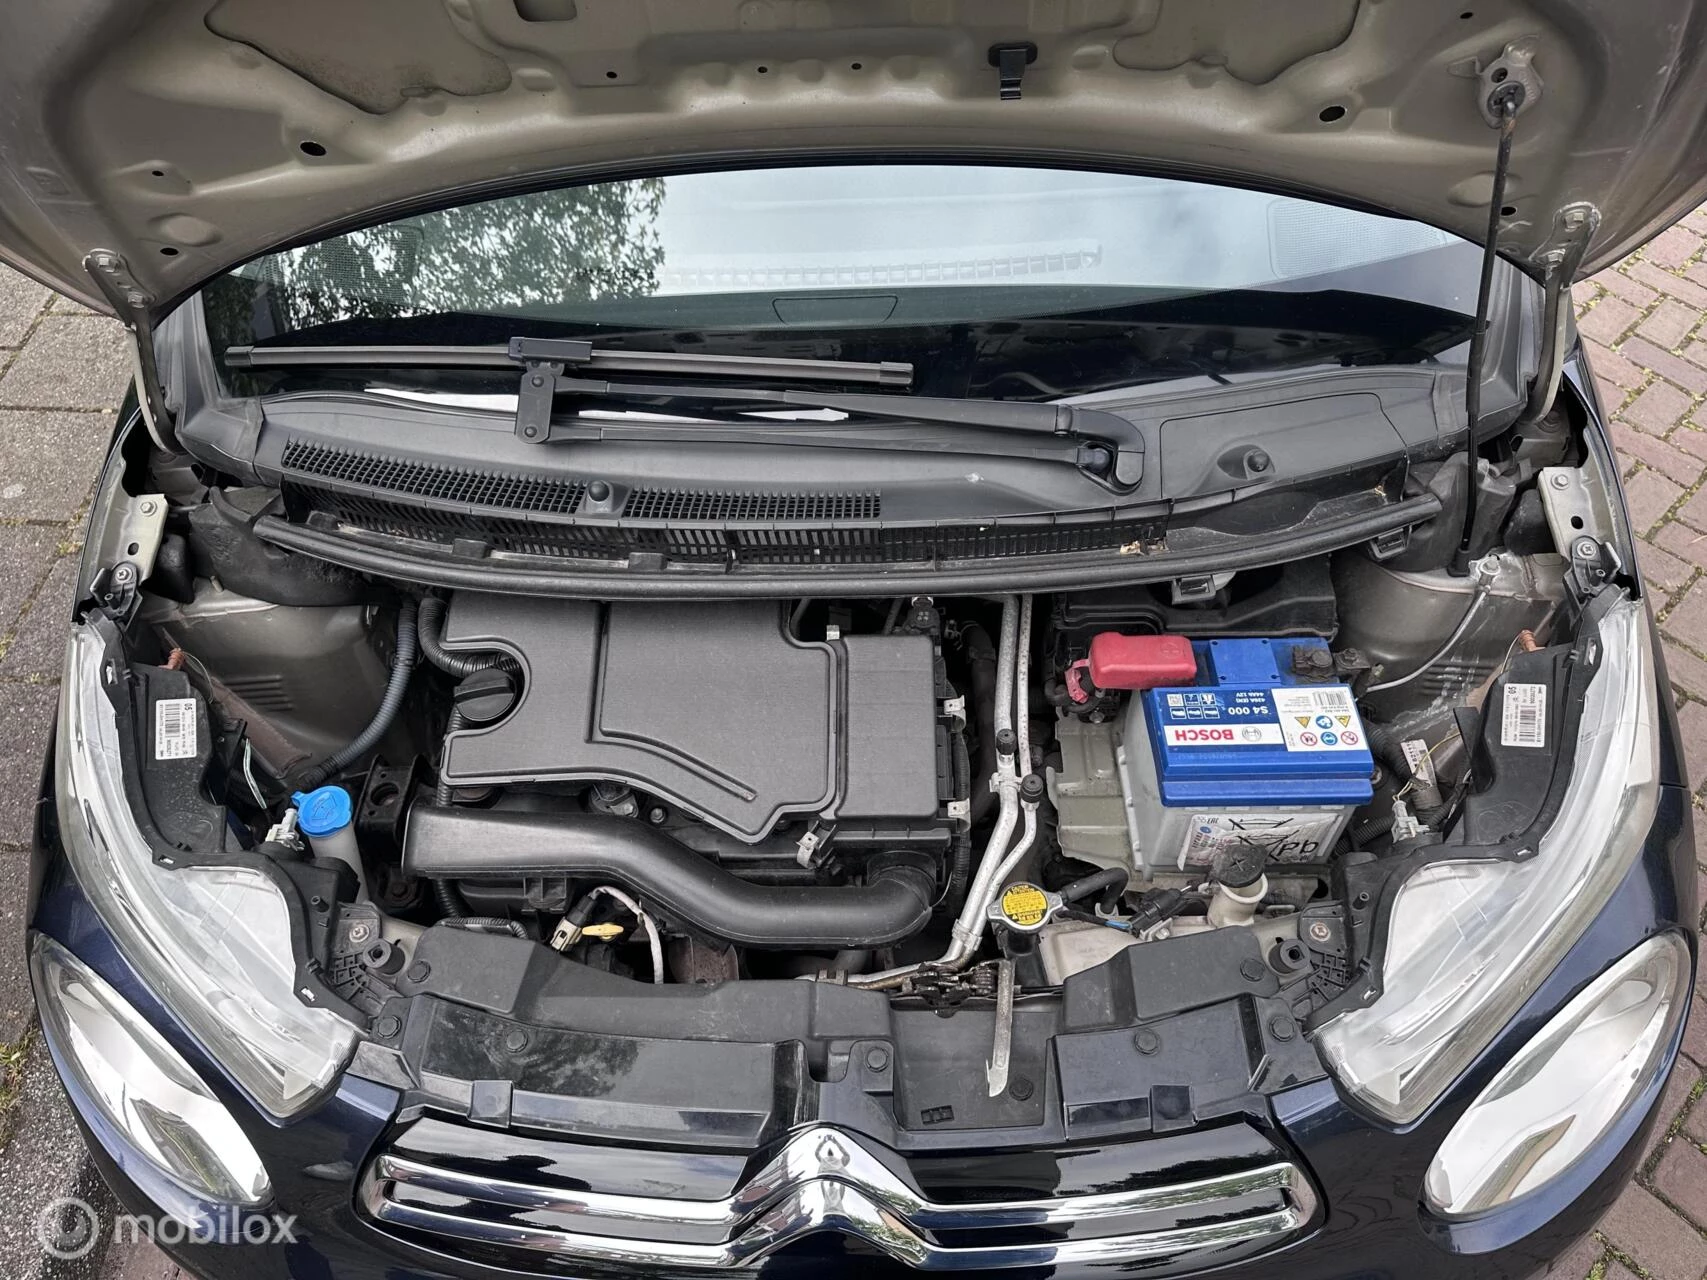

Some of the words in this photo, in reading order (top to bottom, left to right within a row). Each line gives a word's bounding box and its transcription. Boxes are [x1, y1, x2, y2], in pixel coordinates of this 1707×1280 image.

[1227, 705, 1251, 715] 000
[1252, 706, 1269, 715] S4
[1175, 728, 1234, 741] BOSCH
[1278, 840, 1319, 856] Pb
